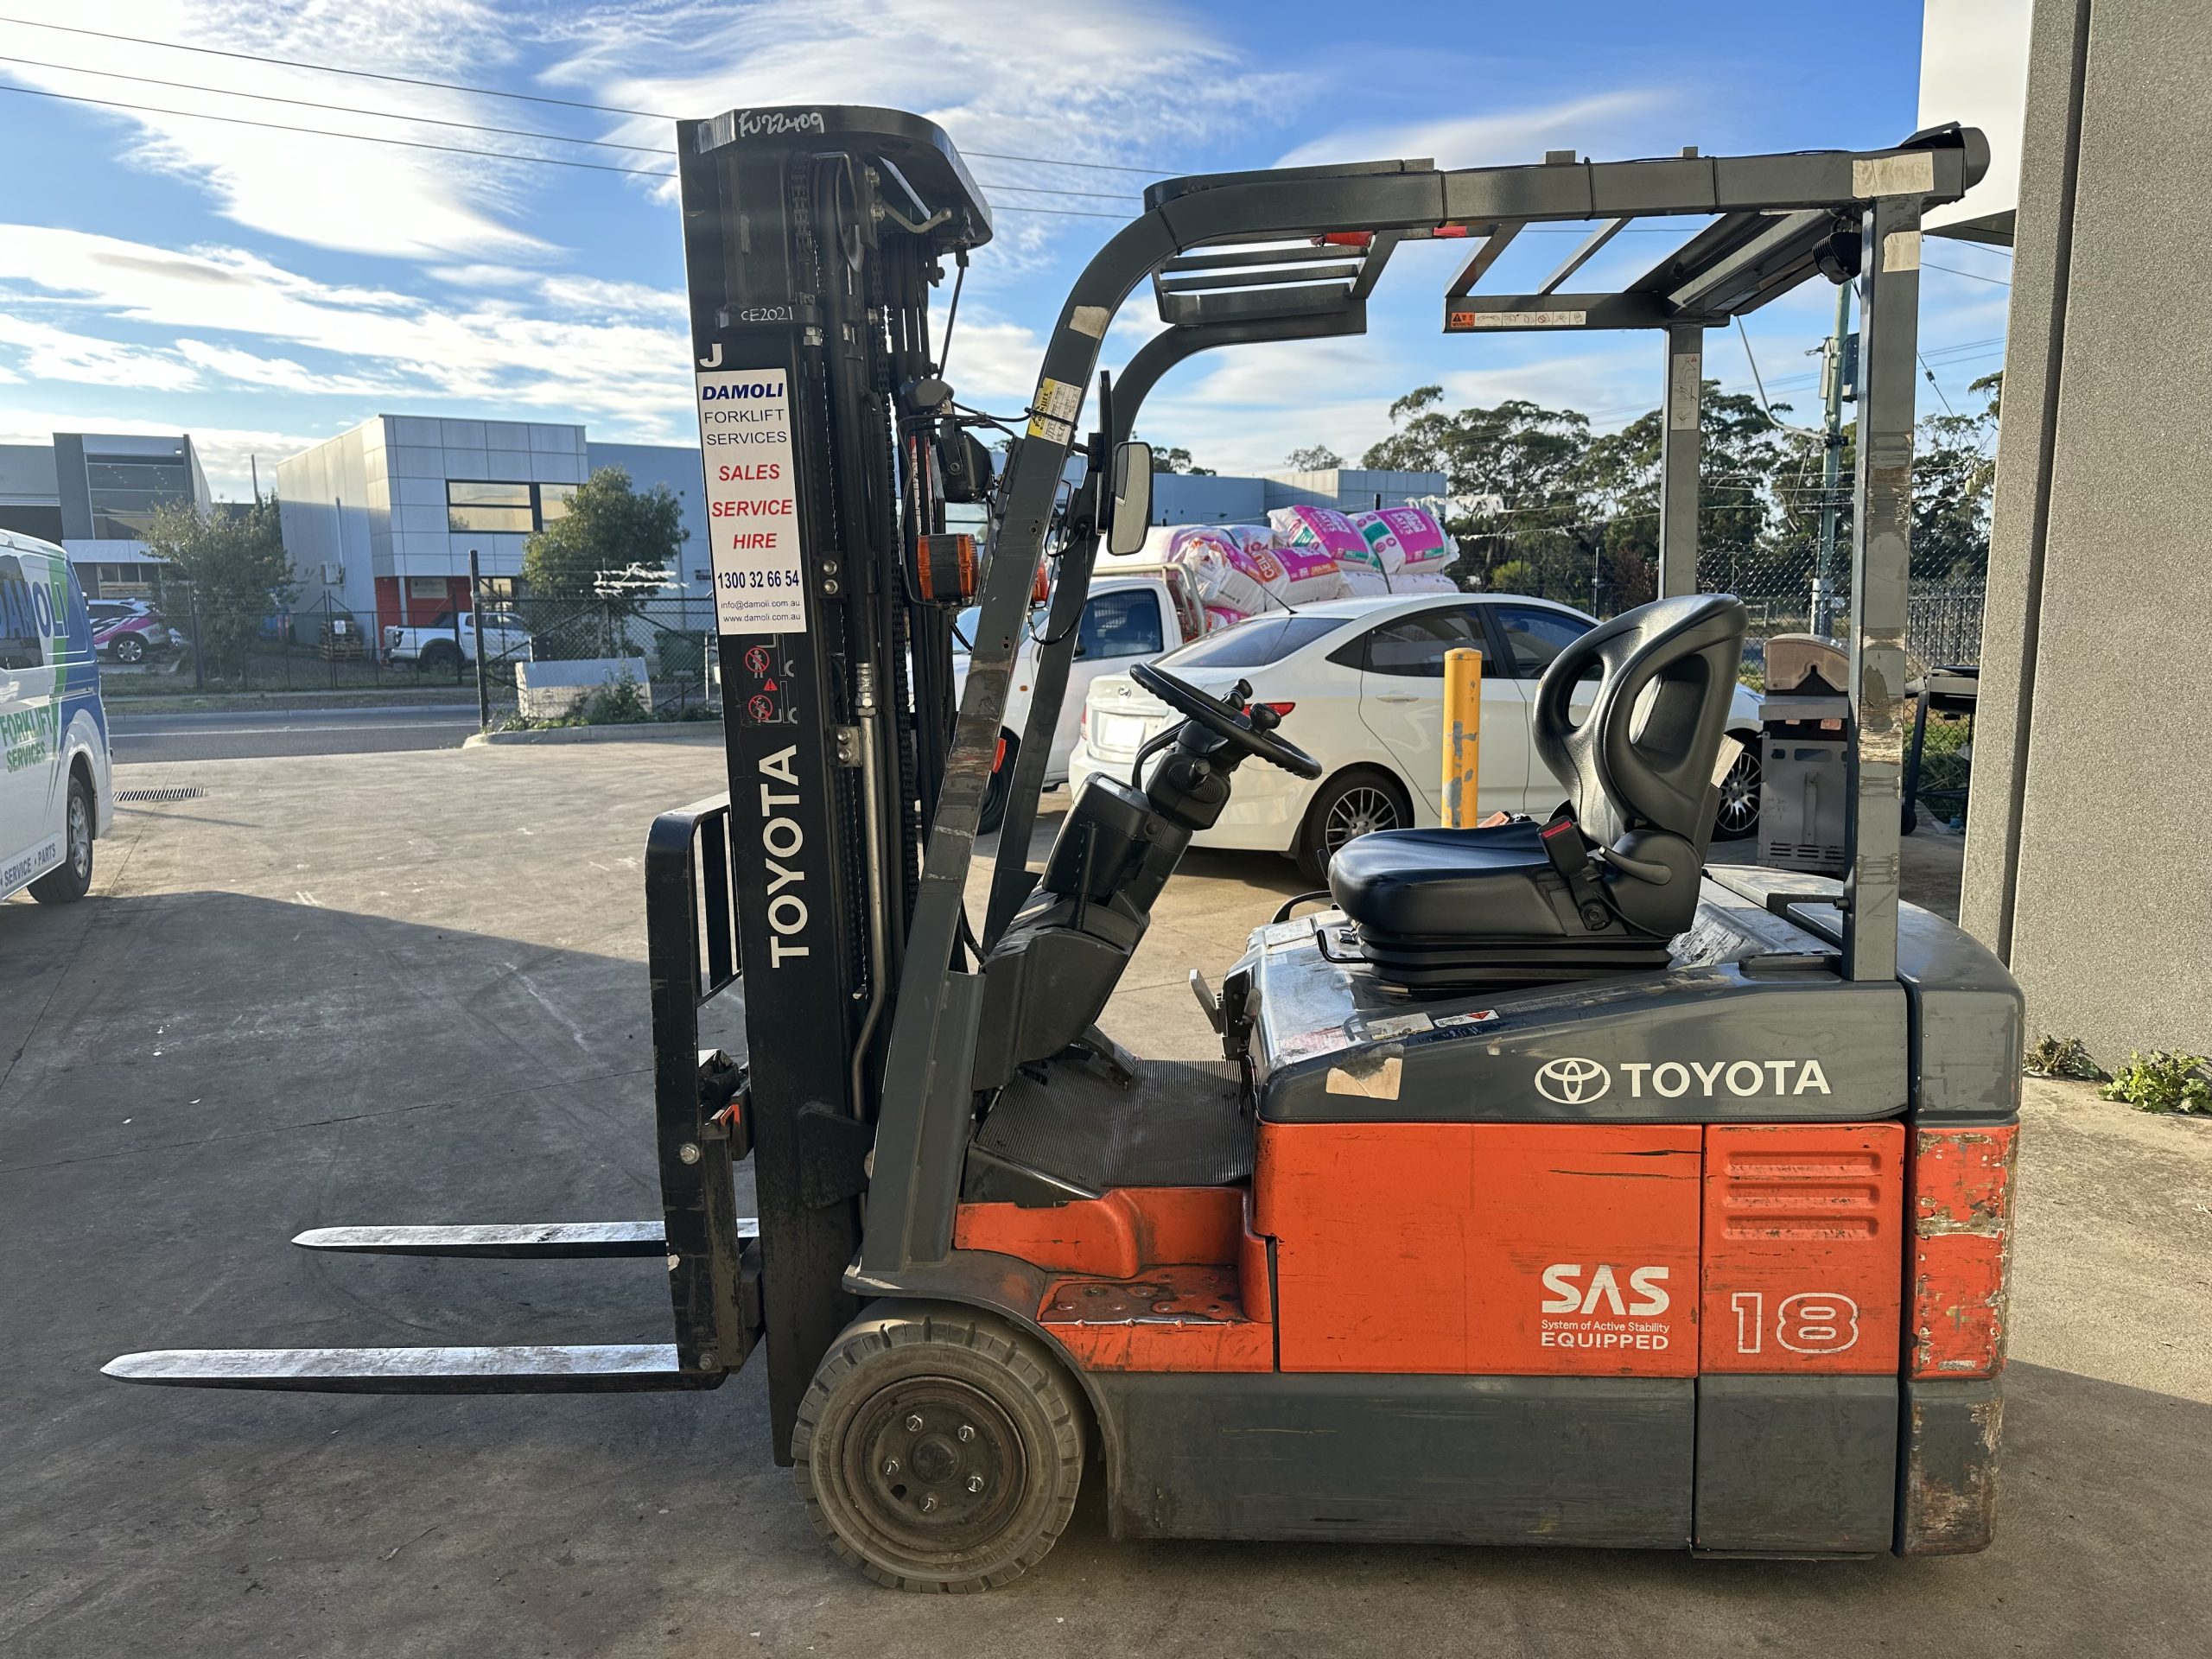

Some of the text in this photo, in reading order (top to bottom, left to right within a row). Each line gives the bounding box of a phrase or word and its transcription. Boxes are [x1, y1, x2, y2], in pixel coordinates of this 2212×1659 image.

[738, 111, 824, 137] FU22409
[741, 305, 793, 321] CE2021
[702, 383, 784, 400] DAMOLI
[704, 409, 785, 423] FORKLIFT
[706, 431, 787, 446] SERVICES
[718, 464, 780, 481] SALES
[711, 499, 793, 518] SERVICE
[733, 532, 778, 550] HIRE
[717, 569, 799, 588] 1300 32 66 54
[721, 600, 800, 610] info@damoli.com.au
[723, 613, 801, 622] www.damoli.com.au
[0, 705, 54, 747] FORKLIFT
[6, 742, 47, 773] SERVICES
[4, 842, 56, 887] SERVICE PARTS
[759, 744, 810, 969] TOYOTA
[1620, 1059, 1832, 1098] TOYOTA
[1541, 1263, 1670, 1316] SAS
[1541, 1319, 1670, 1334] System of Active Stability
[1731, 1292, 1859, 1354] 18
[1541, 1332, 1669, 1351] EQUIPPED
